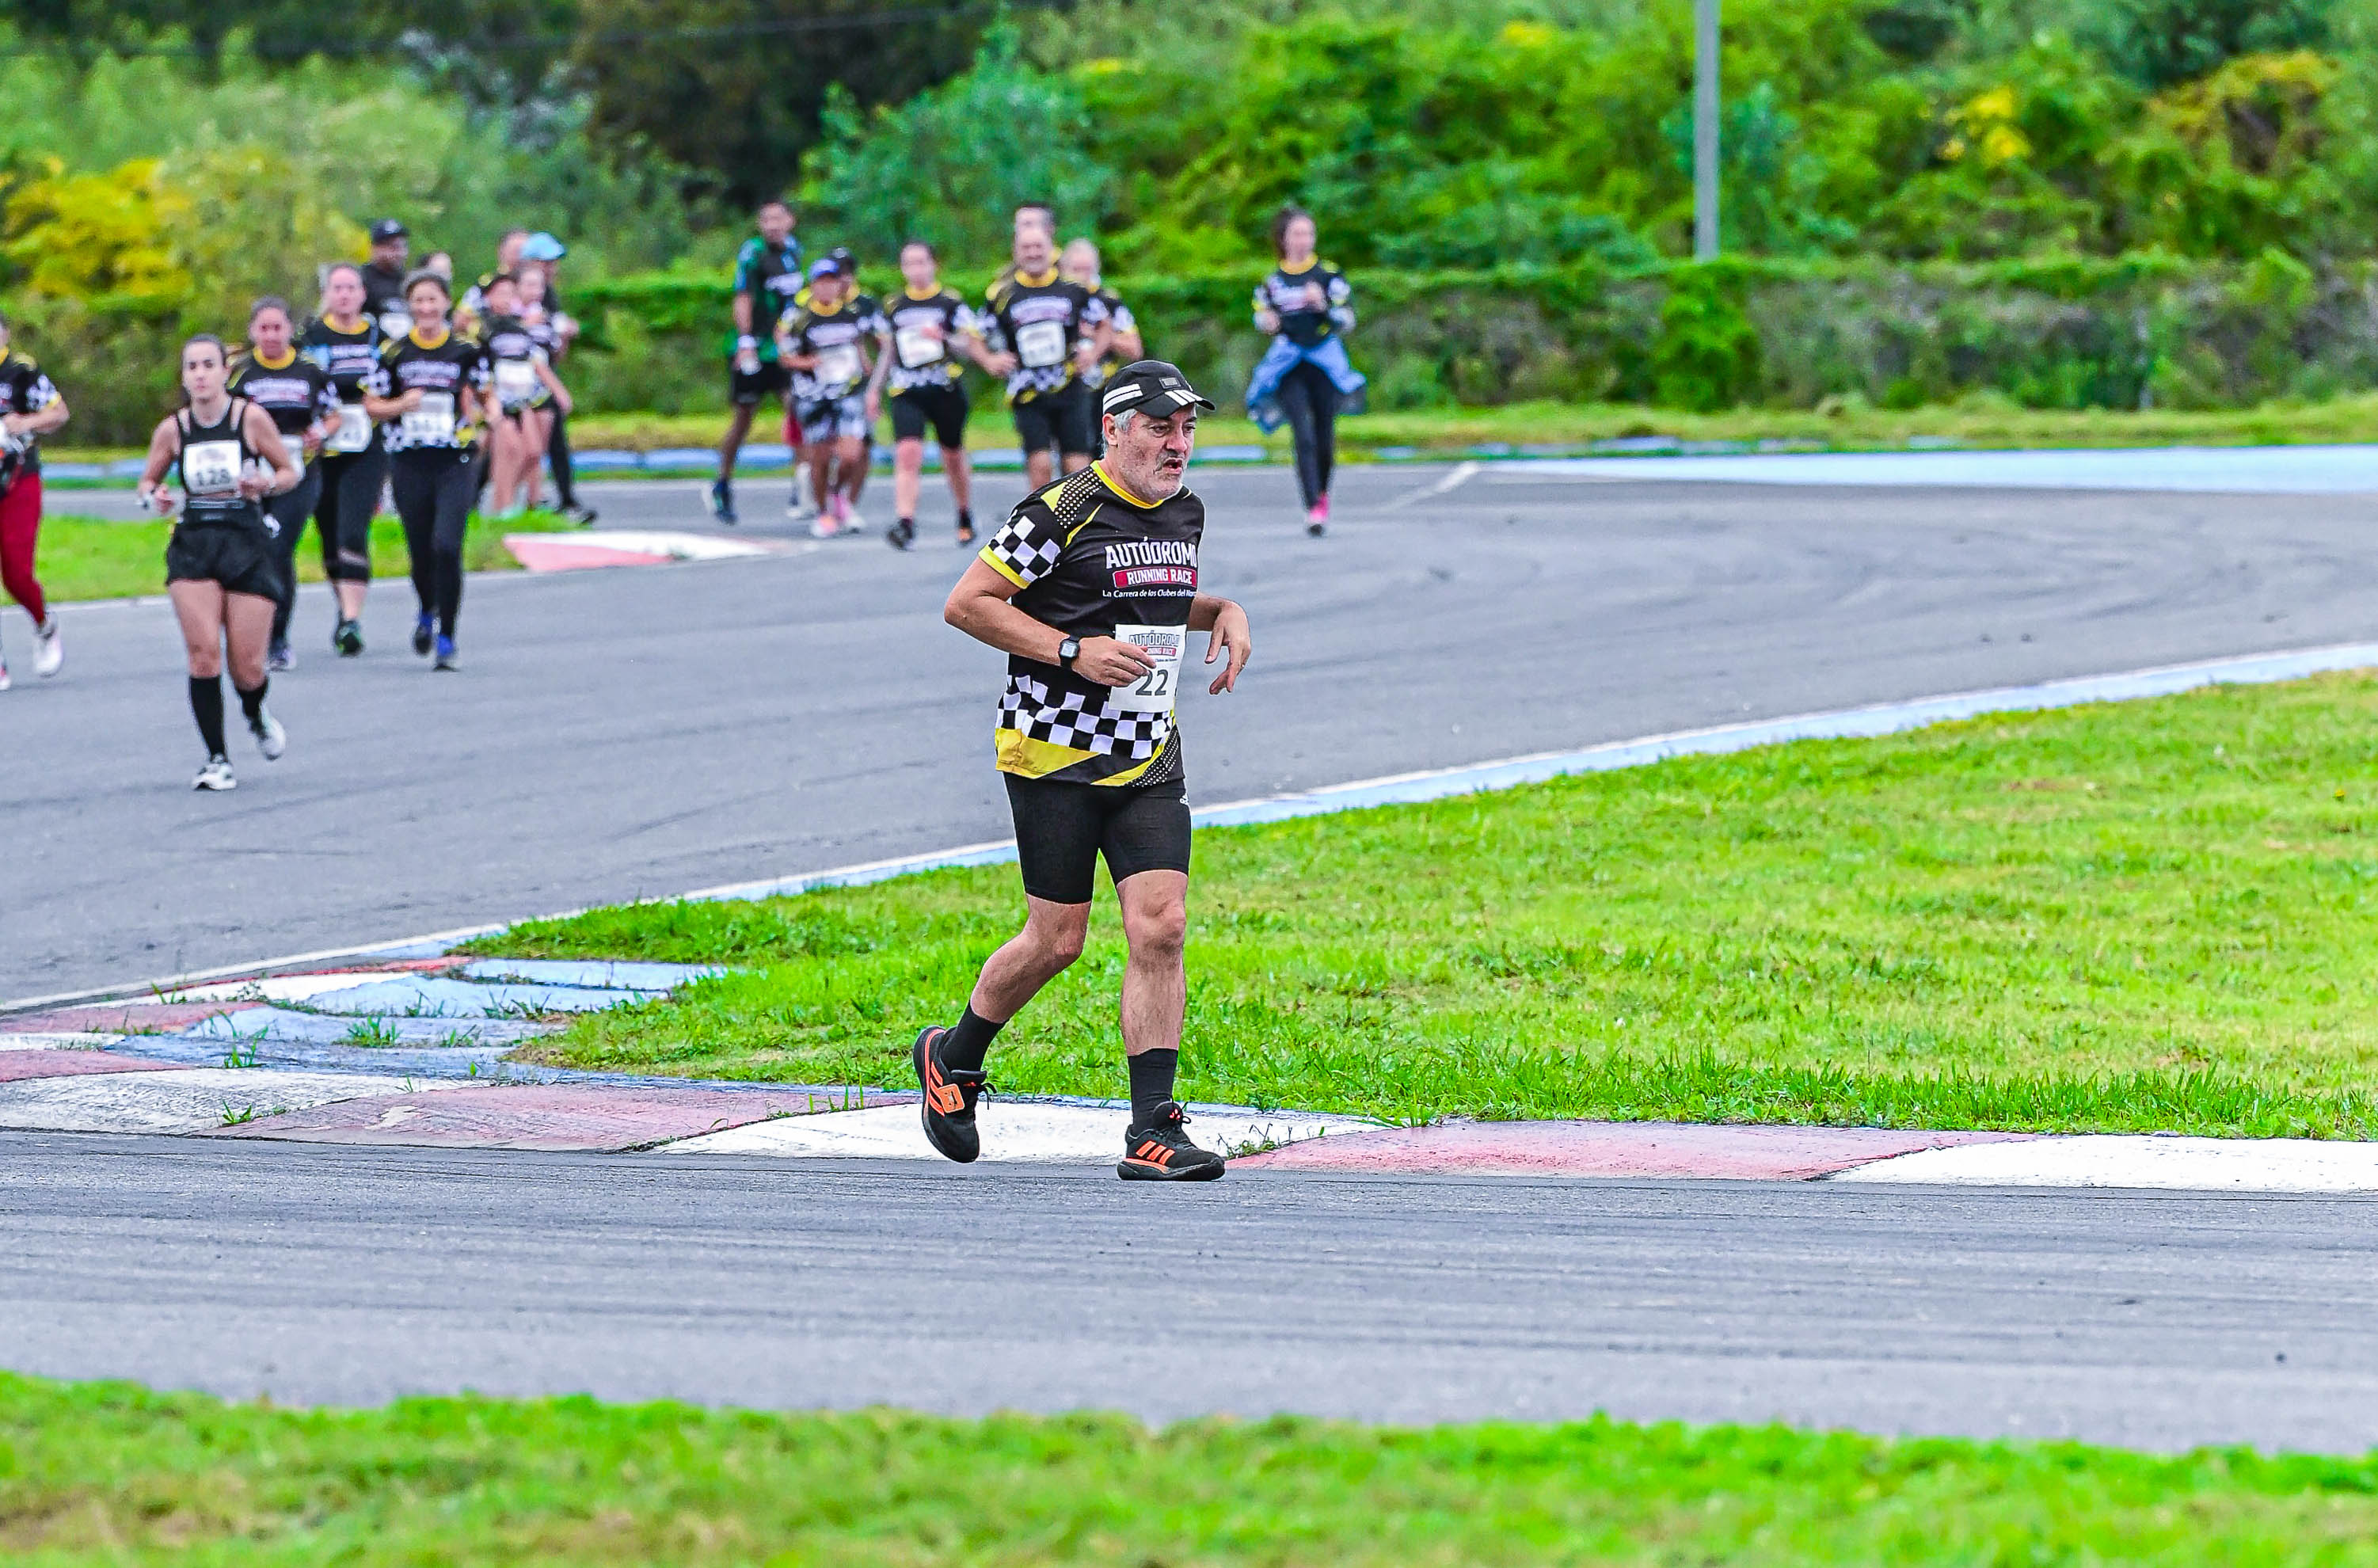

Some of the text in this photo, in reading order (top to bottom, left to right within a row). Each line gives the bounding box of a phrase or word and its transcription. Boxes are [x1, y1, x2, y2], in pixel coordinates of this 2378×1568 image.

[1126, 569, 1193, 585] RUNNING RACE
[1136, 669, 1168, 696] 22
